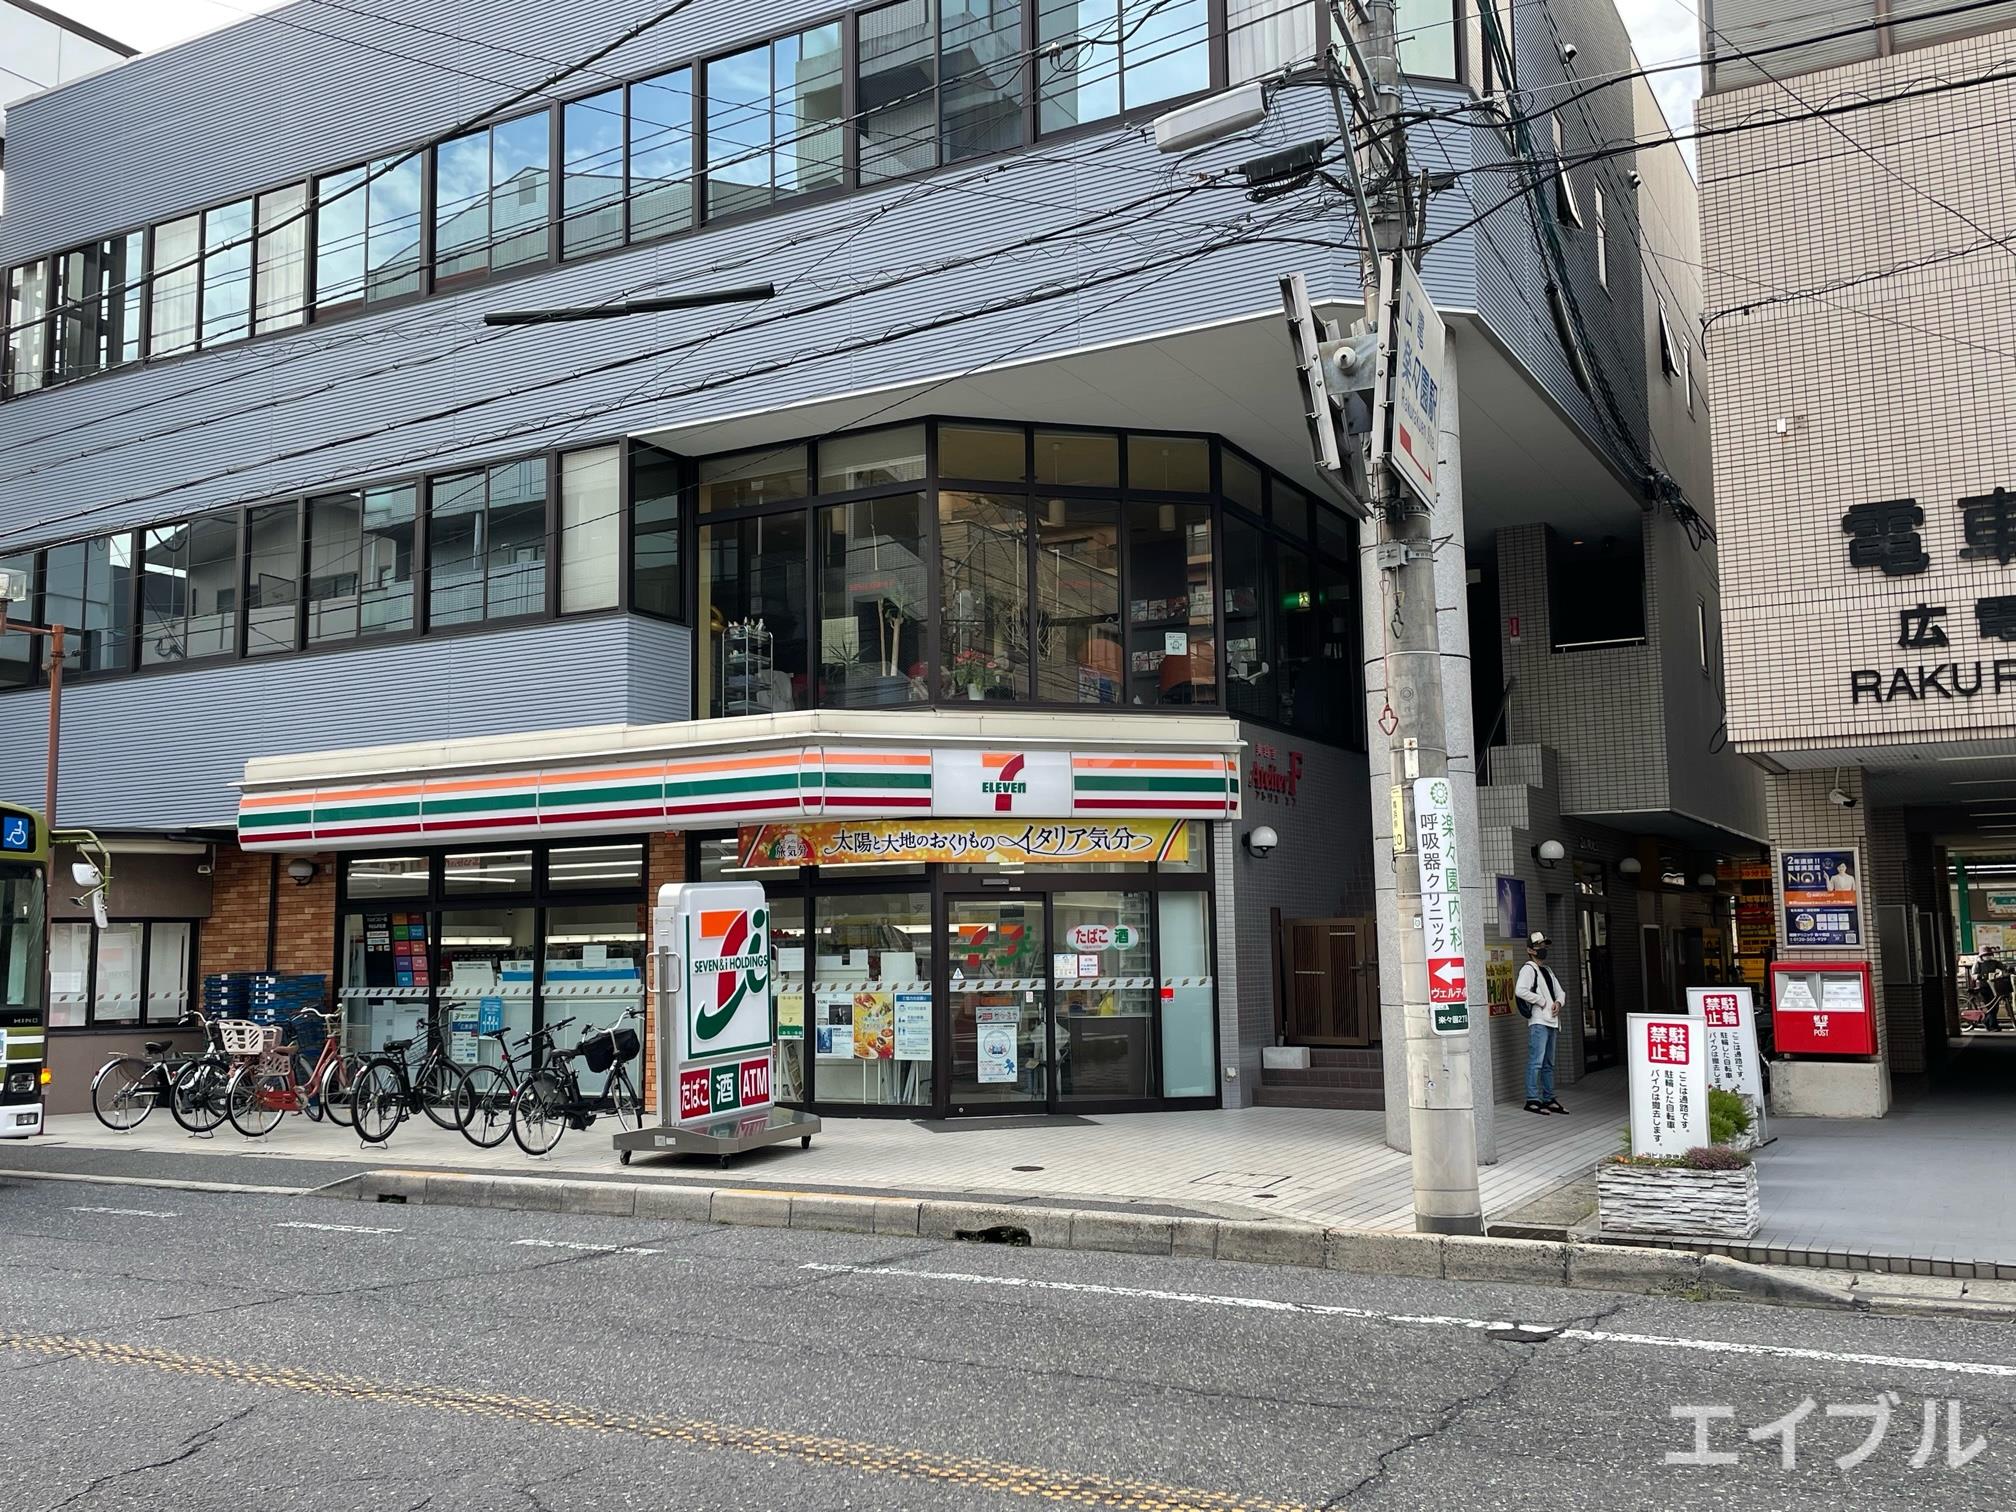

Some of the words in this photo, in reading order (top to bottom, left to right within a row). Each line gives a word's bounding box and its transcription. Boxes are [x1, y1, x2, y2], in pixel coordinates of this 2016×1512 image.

[823, 828, 996, 857] 太陽と大地のおくりもの
[1000, 825, 1150, 855] イタリア気分
[1420, 813, 1445, 953] 呼吸器クリニック
[1075, 928, 1109, 944] たばこ
[1114, 928, 1129, 944] 酒
[729, 953, 768, 970] HOLDINGS
[1813, 1029, 1829, 1037] POST
[681, 1077, 709, 1111] たばこ
[715, 1071, 735, 1105] 酒
[742, 1065, 768, 1099] ATM
[1679, 1070, 1690, 1133] ここは通路です。
